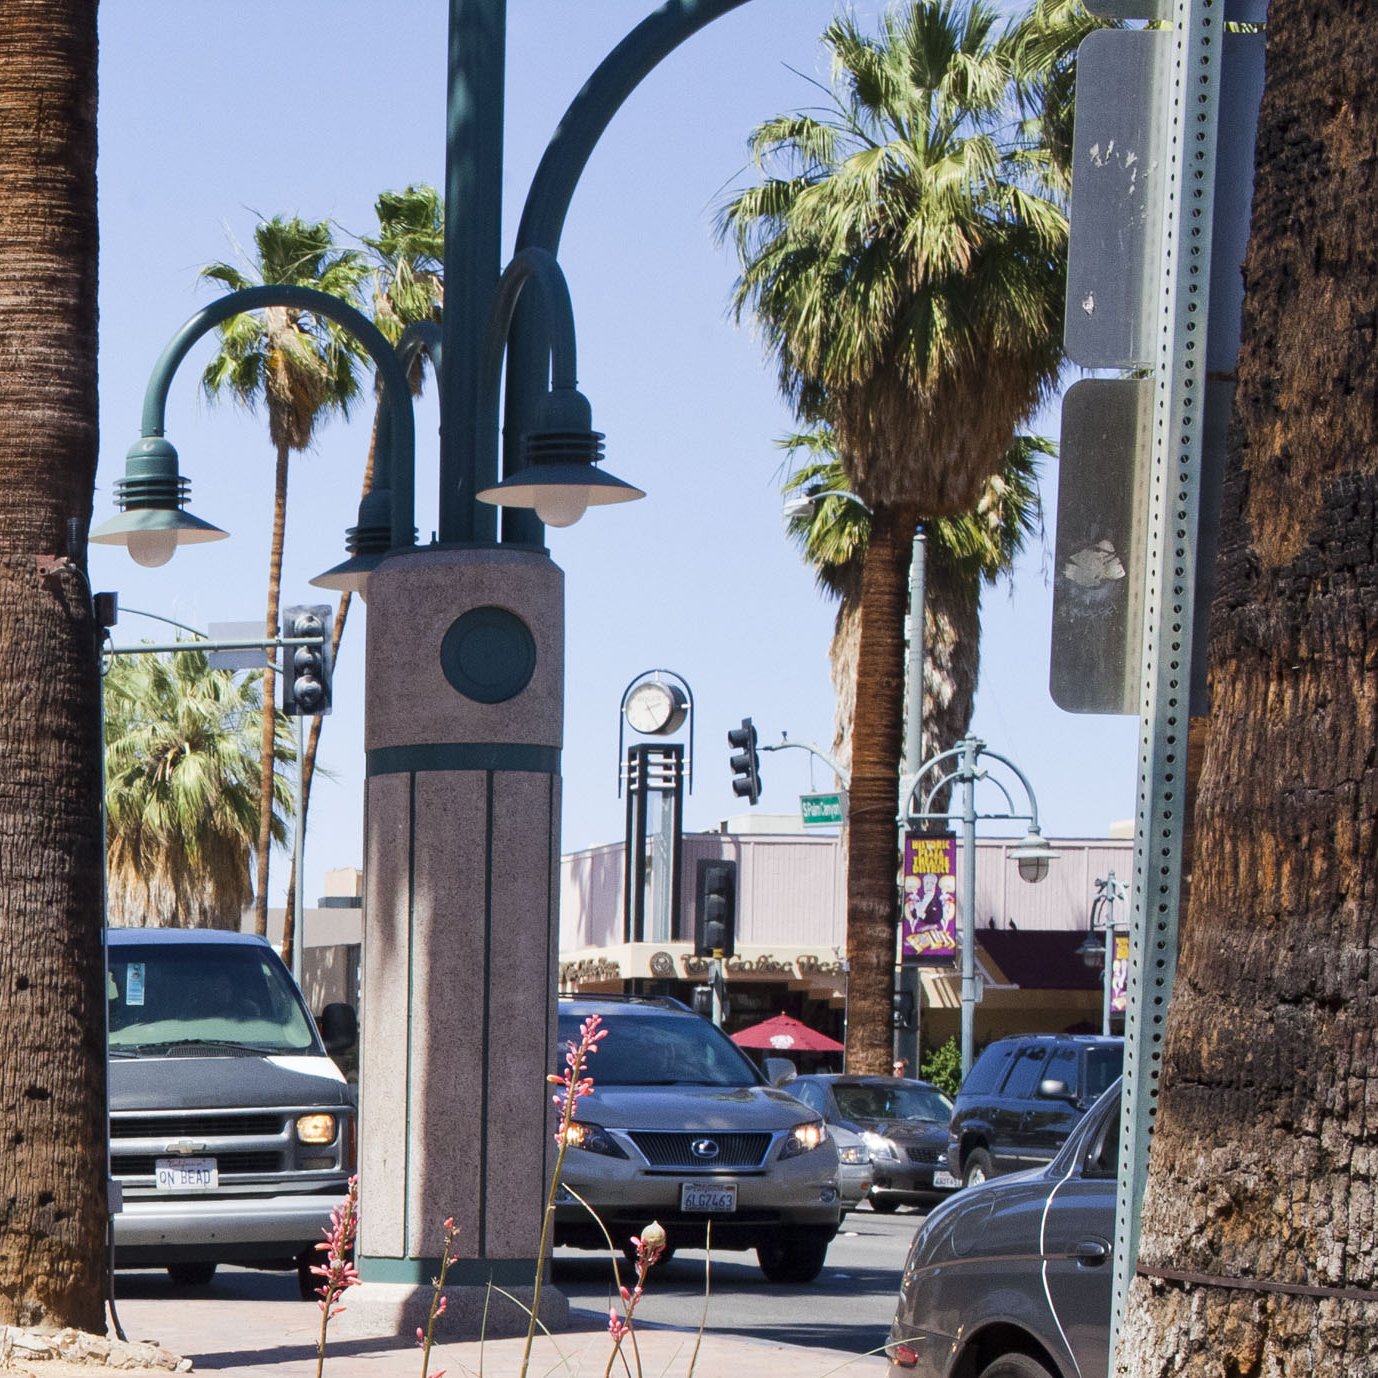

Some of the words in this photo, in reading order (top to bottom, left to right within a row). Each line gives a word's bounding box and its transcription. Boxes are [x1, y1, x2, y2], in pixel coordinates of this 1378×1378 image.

[912, 840, 950, 850] HISTORIC
[912, 865, 950, 874] DISTRICT
[724, 954, 794, 975] Coffee
[159, 1171, 175, 1184] ON
[180, 1170, 211, 1184] BEAD
